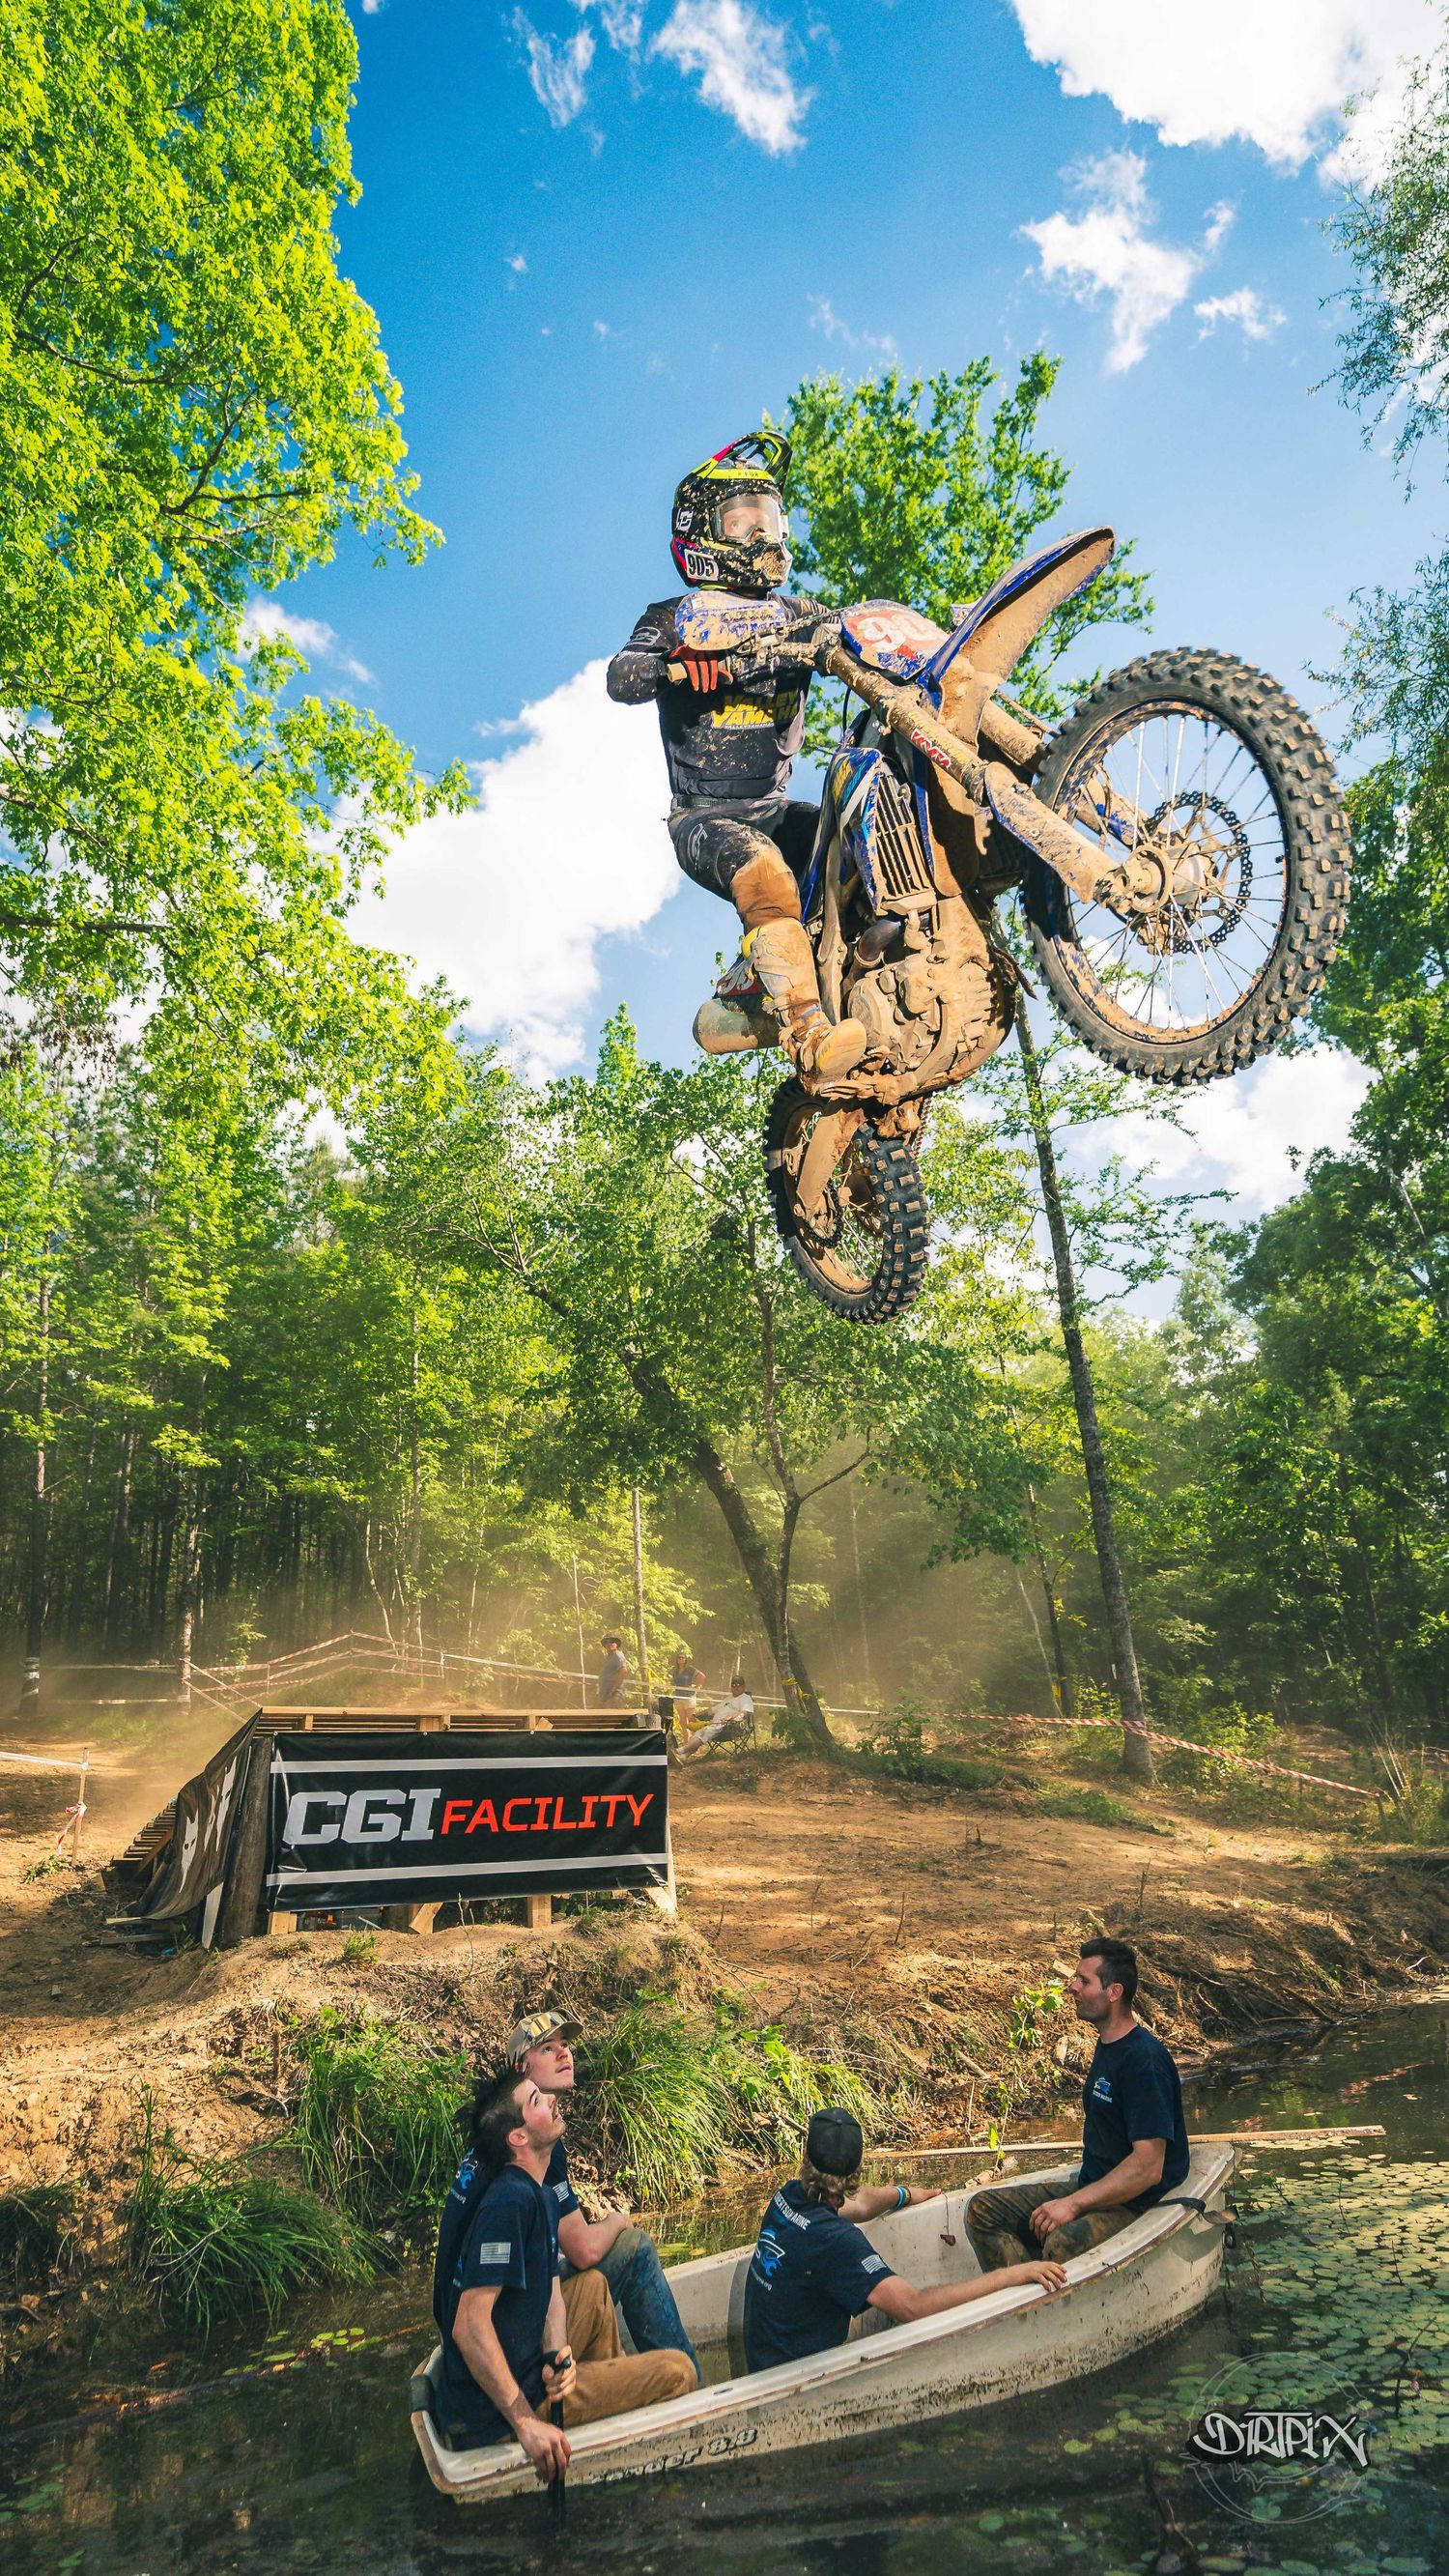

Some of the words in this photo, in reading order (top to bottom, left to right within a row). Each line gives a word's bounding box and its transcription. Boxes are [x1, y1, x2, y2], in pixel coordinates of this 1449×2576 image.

[687, 552, 715, 578] 905
[281, 1788, 441, 1846] CGI
[440, 1792, 655, 1836] FACILITY
